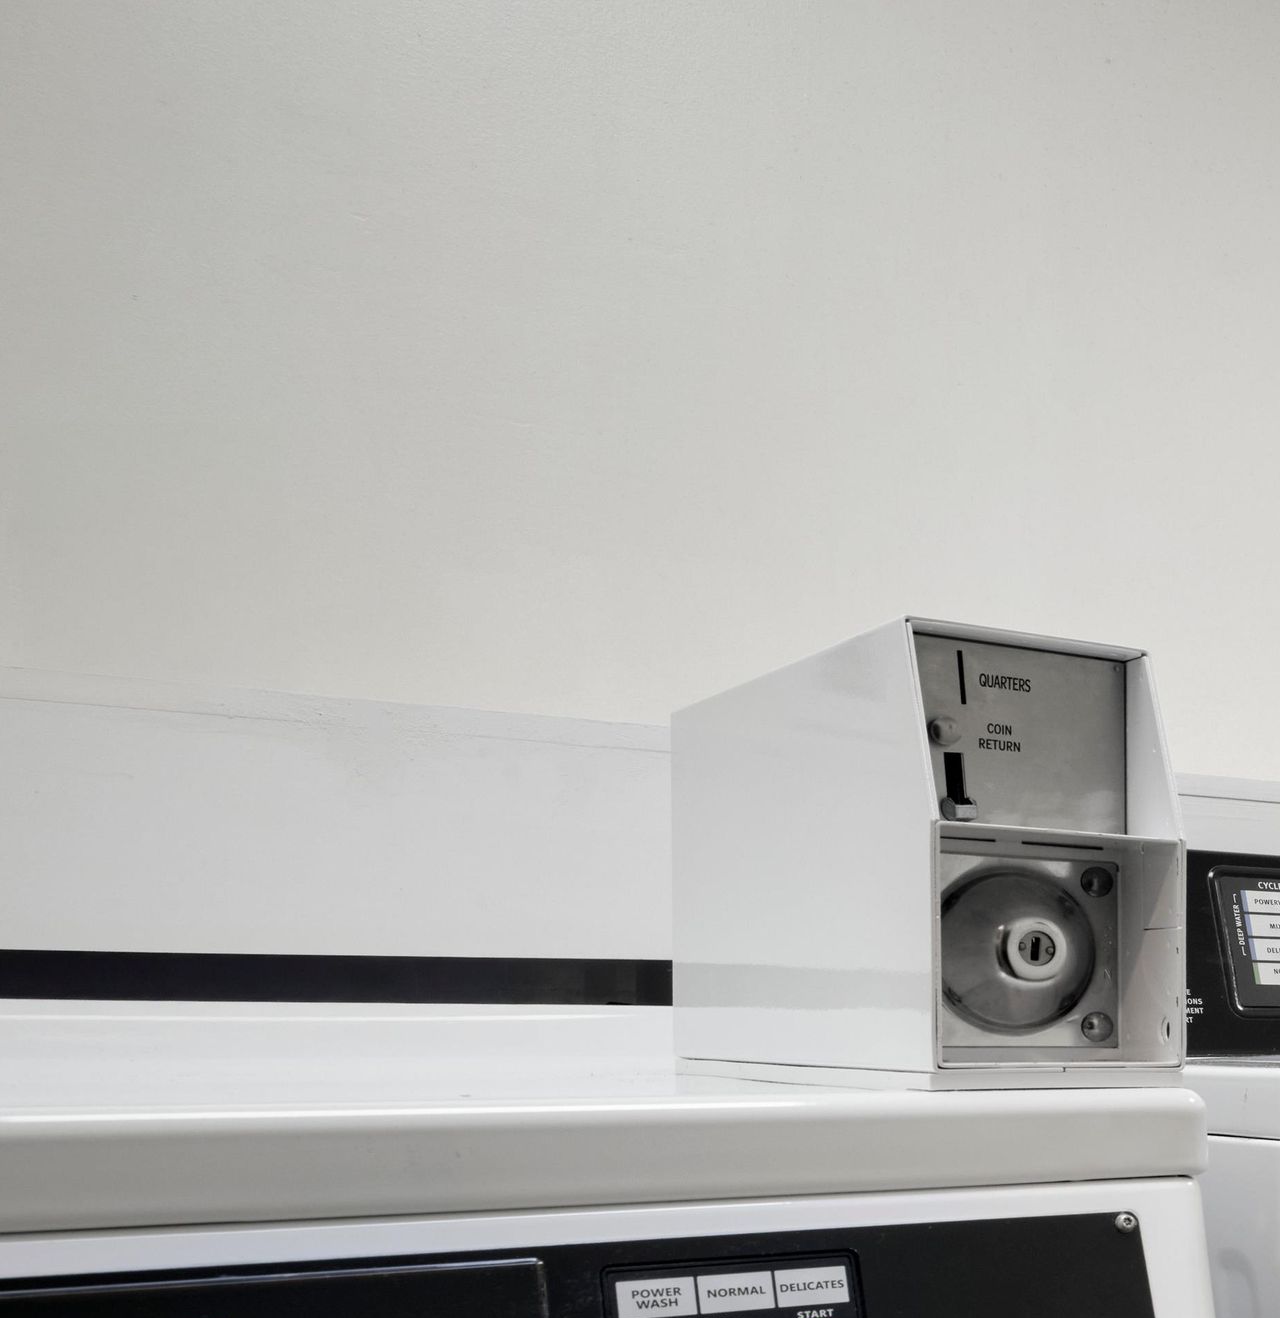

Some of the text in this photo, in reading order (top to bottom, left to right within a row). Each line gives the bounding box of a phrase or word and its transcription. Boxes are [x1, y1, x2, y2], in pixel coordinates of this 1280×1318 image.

[979, 673, 1031, 693] QUARTERS
[987, 723, 1012, 736] COIN
[978, 738, 1021, 752] RETURN
[1232, 904, 1246, 946] DEEP WATER
[707, 1286, 766, 1299] NORMAL
[780, 1279, 845, 1293] DELICATES
[631, 1287, 682, 1299] POWER
[636, 1298, 678, 1310] WASH
